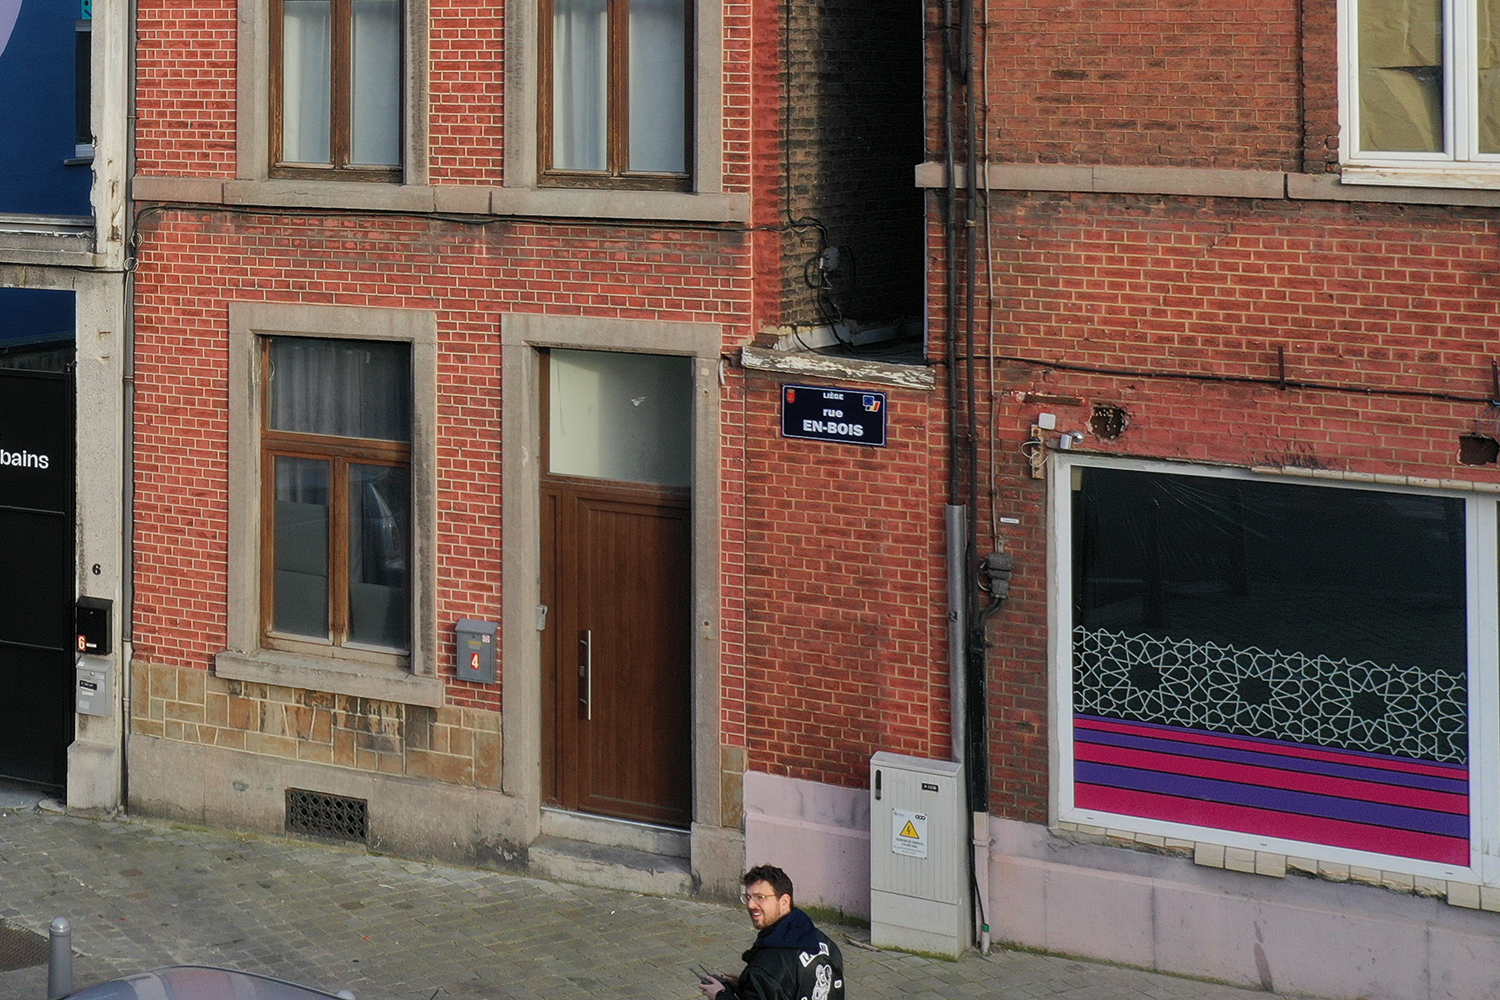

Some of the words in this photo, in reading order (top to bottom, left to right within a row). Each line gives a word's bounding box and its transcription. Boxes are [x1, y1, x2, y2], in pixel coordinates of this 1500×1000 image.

[822, 408, 844, 418] rue
[802, 419, 864, 437] EN-BOIS
[92, 563, 101, 576] 6
[78, 636, 85, 650] 6
[471, 654, 479, 669] 4
